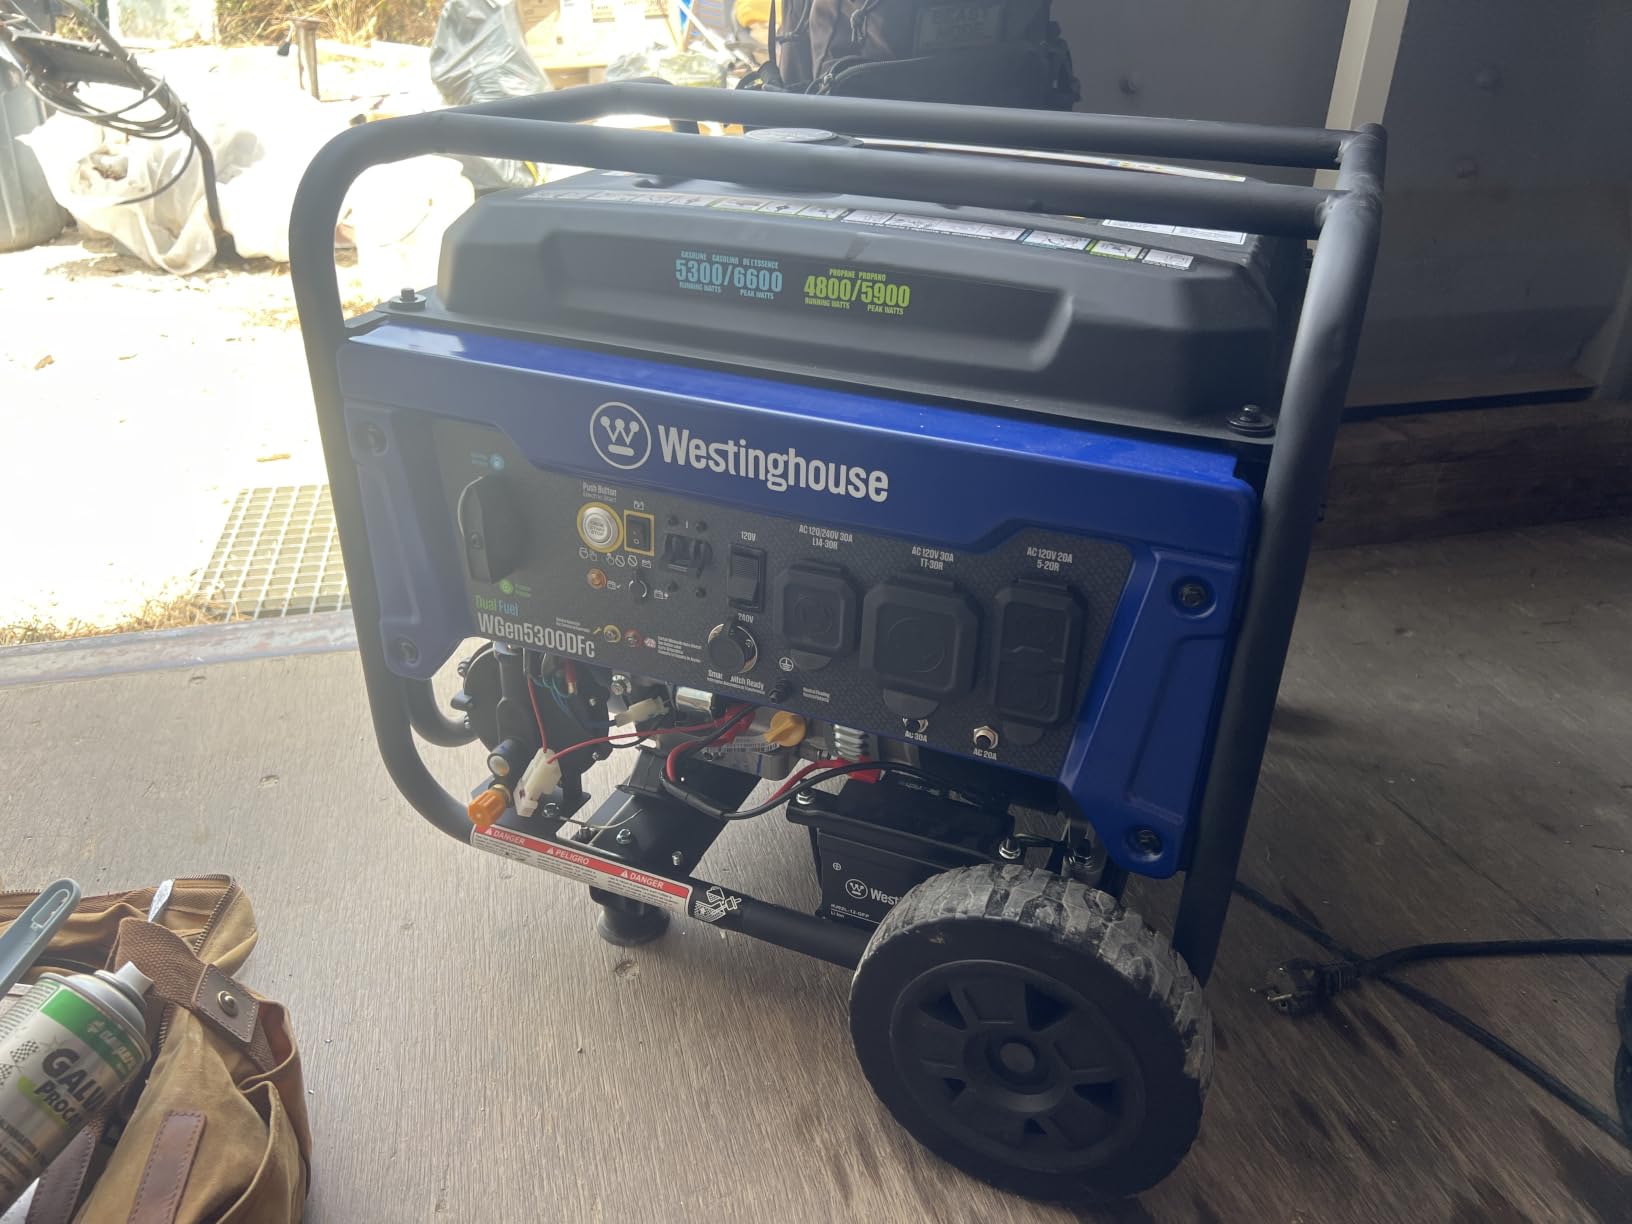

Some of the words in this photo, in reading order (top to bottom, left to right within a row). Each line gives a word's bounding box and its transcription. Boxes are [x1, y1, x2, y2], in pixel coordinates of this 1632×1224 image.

[675, 259, 783, 292] 5300/6600
[829, 268, 855, 278] PROPANE
[858, 271, 887, 281] PROPANO
[740, 288, 755, 297] PEAK
[755, 291, 774, 300] WATTS
[803, 275, 911, 307] 4800/5900
[831, 300, 850, 309] WATTS
[867, 304, 883, 313] PEAK
[884, 306, 904, 315] WATTS
[658, 424, 889, 503] Westinghouse
[582, 481, 598, 494] Push
[741, 530, 756, 542] 120V
[798, 524, 808, 534] AC
[839, 532, 853, 543] 30A
[812, 537, 838, 550] L14-30R
[911, 545, 921, 556] AC
[922, 548, 939, 560] 120V
[940, 551, 954, 563] 30A
[1026, 546, 1036, 557] AC
[1038, 549, 1057, 561] 120V
[1057, 551, 1073, 563] 20A
[920, 557, 944, 571] TT-30R
[1036, 559, 1060, 572] 5-20R
[475, 594, 497, 611] Dual
[498, 600, 519, 617] Fuel
[738, 612, 754, 624] 240V
[477, 611, 595, 658] WGen5300DFc
[746, 677, 765, 691] Ready
[914, 732, 928, 742] 30A
[972, 748, 983, 757] AC
[983, 750, 997, 760] 20A
[493, 830, 526, 845] DANGER
[555, 848, 589, 865] PELIGRO
[629, 872, 664, 889] DANGER
